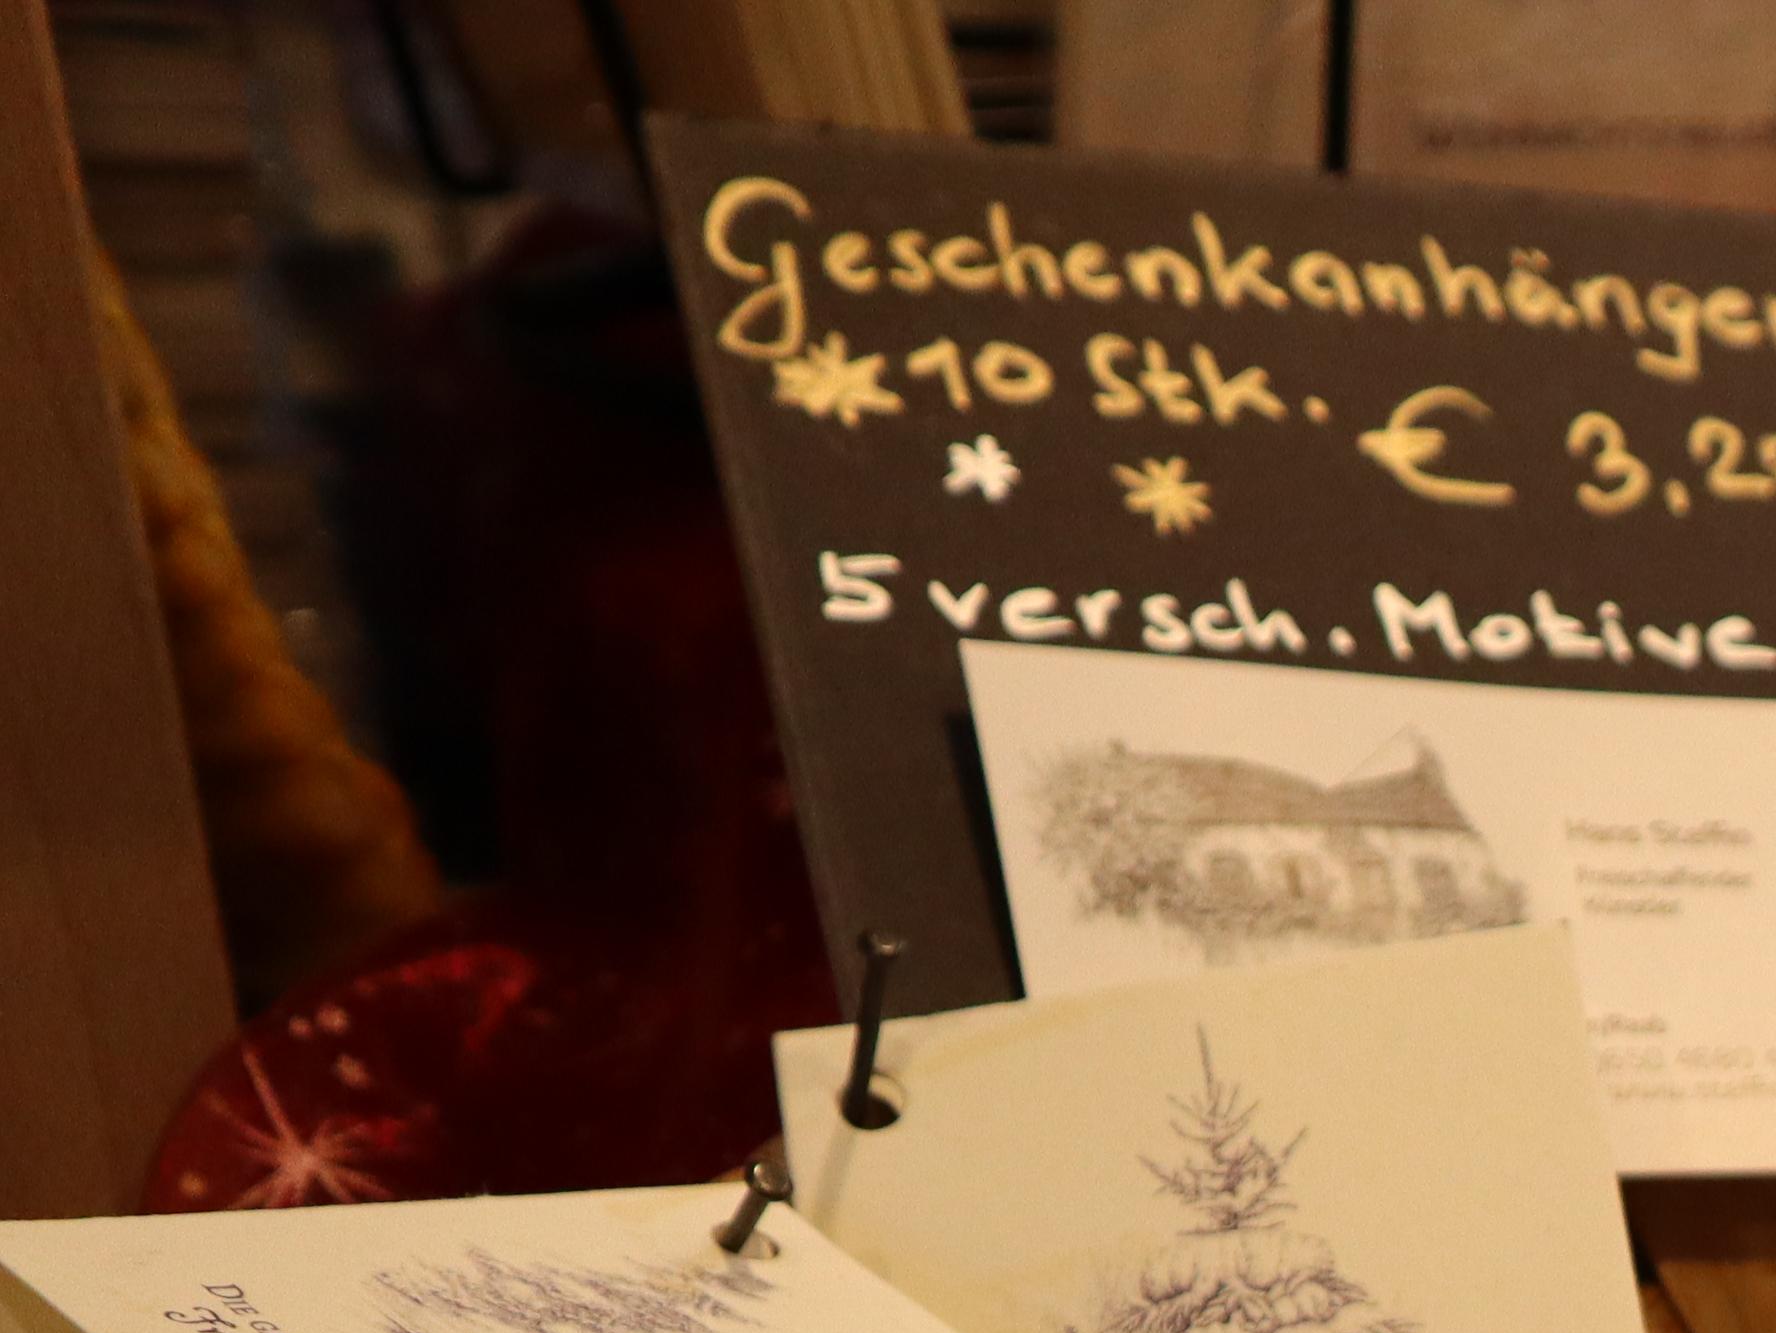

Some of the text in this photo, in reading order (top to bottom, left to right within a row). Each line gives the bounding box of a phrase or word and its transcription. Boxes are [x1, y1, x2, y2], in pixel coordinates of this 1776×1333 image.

[908, 332, 1331, 425] 10 Stk.
[1358, 384, 1515, 506] €
[820, 551, 899, 621] 5
[929, 577, 1357, 659] versch.
